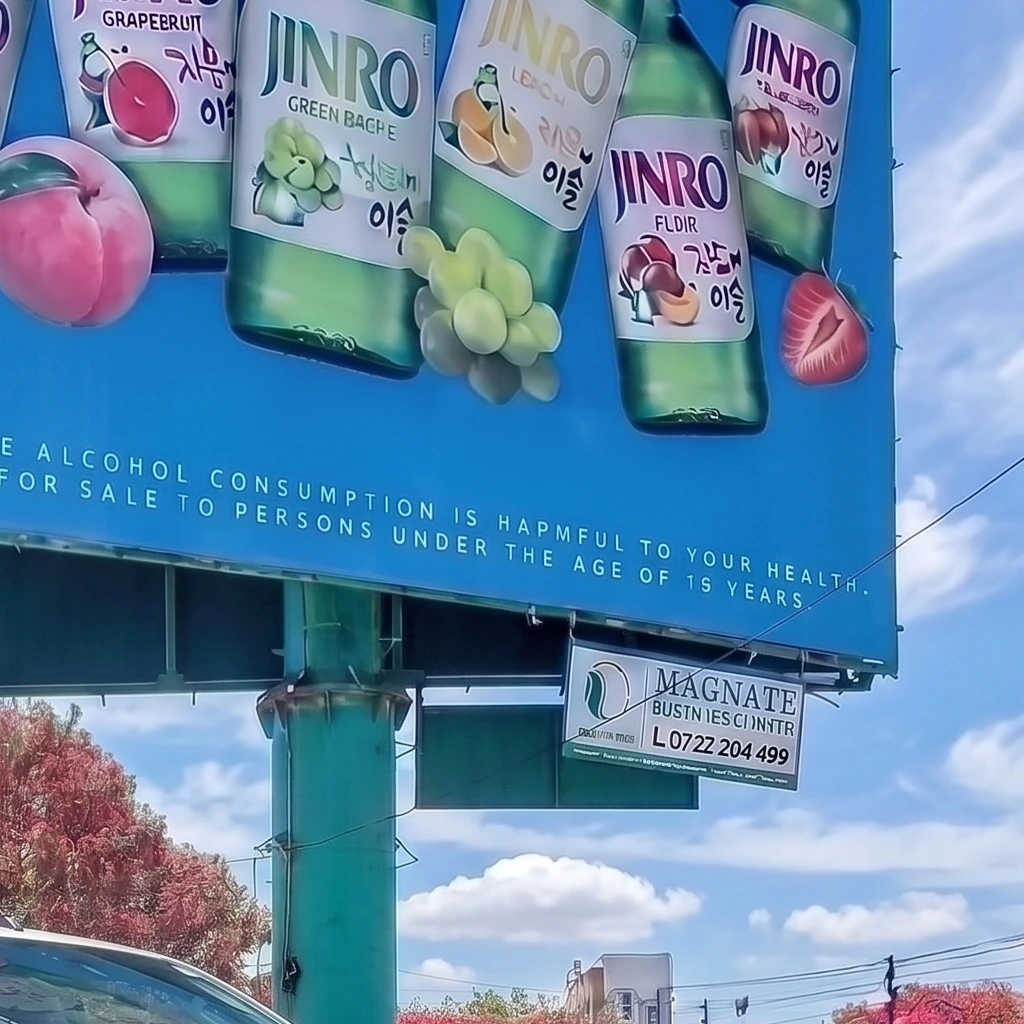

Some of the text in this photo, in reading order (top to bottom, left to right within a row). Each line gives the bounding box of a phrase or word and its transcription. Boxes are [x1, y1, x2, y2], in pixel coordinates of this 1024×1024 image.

[260, 11, 420, 118] JINRO
[477, 0, 612, 106] JINRO
[739, 22, 842, 106] JINRO
[287, 95, 340, 124] GREEN
[610, 149, 728, 224] JINRO
[36, 442, 188, 484] ALCOHOL
[210, 468, 434, 521] CONSUMPTION
[454, 506, 477, 527] IS
[639, 538, 671, 560] TO
[686, 546, 752, 573] YOUR
[79, 479, 157, 510] SALE
[177, 494, 214, 517] TO
[235, 501, 372, 540] PERSONS
[392, 525, 487, 557] UNDER
[505, 543, 554, 568] THE
[573, 555, 622, 579] AGE
[639, 567, 669, 587] OF
[654, 667, 797, 716] MAGNATE
[717, 737, 753, 761] 204
[755, 744, 790, 766] 499
